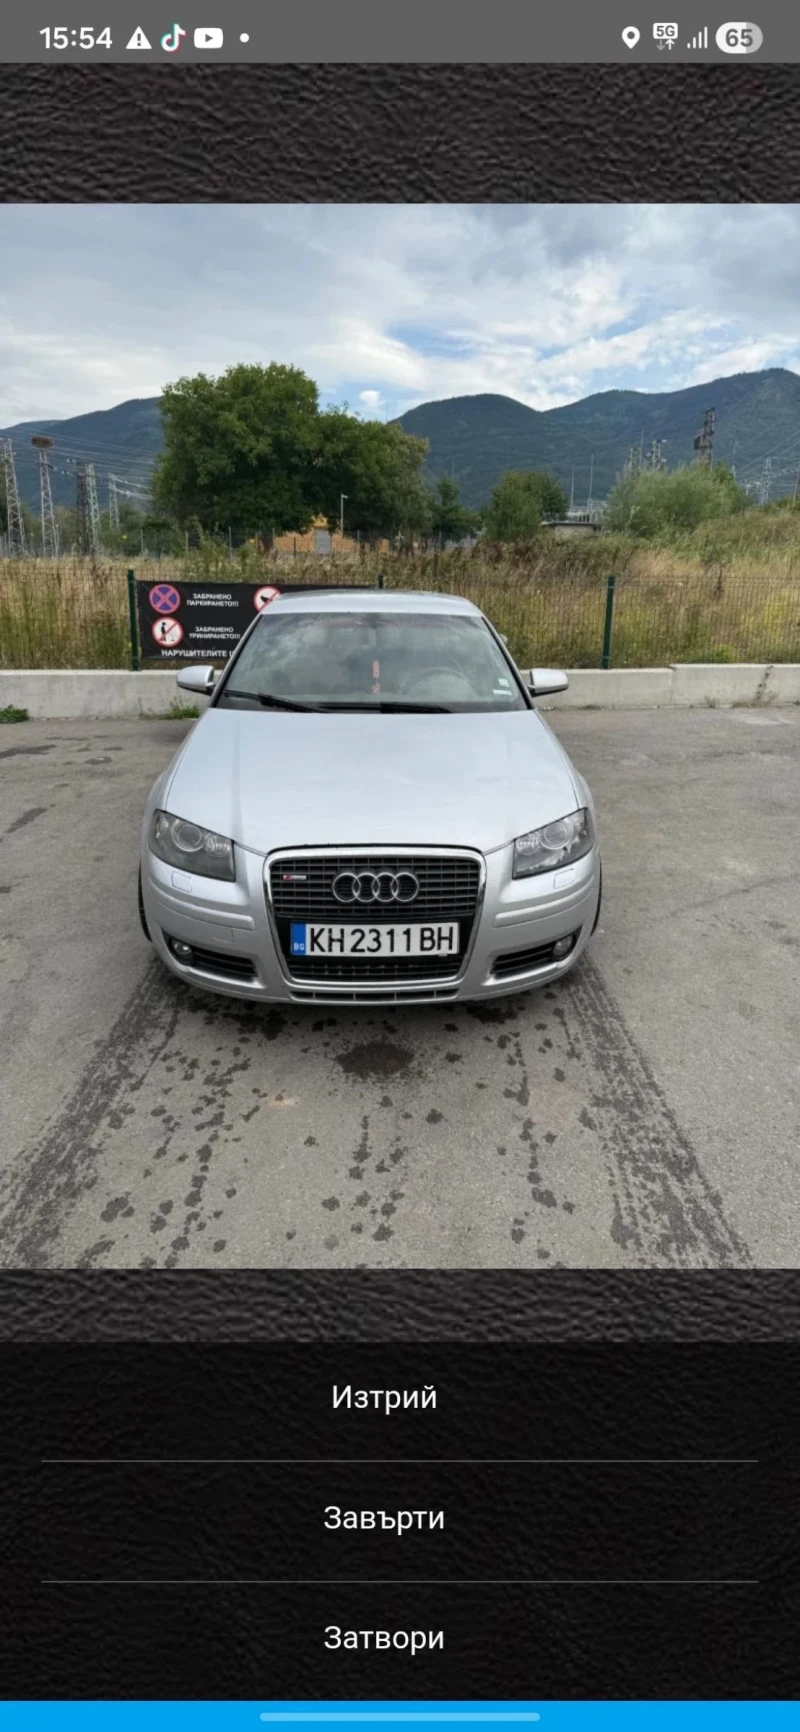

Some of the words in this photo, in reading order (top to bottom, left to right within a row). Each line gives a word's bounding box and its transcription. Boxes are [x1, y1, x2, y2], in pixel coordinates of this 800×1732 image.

[161, 649, 227, 657] НАРУШИТЕЛИТЕ
[350, 927, 411, 953] 2311
[293, 942, 305, 951] BG
